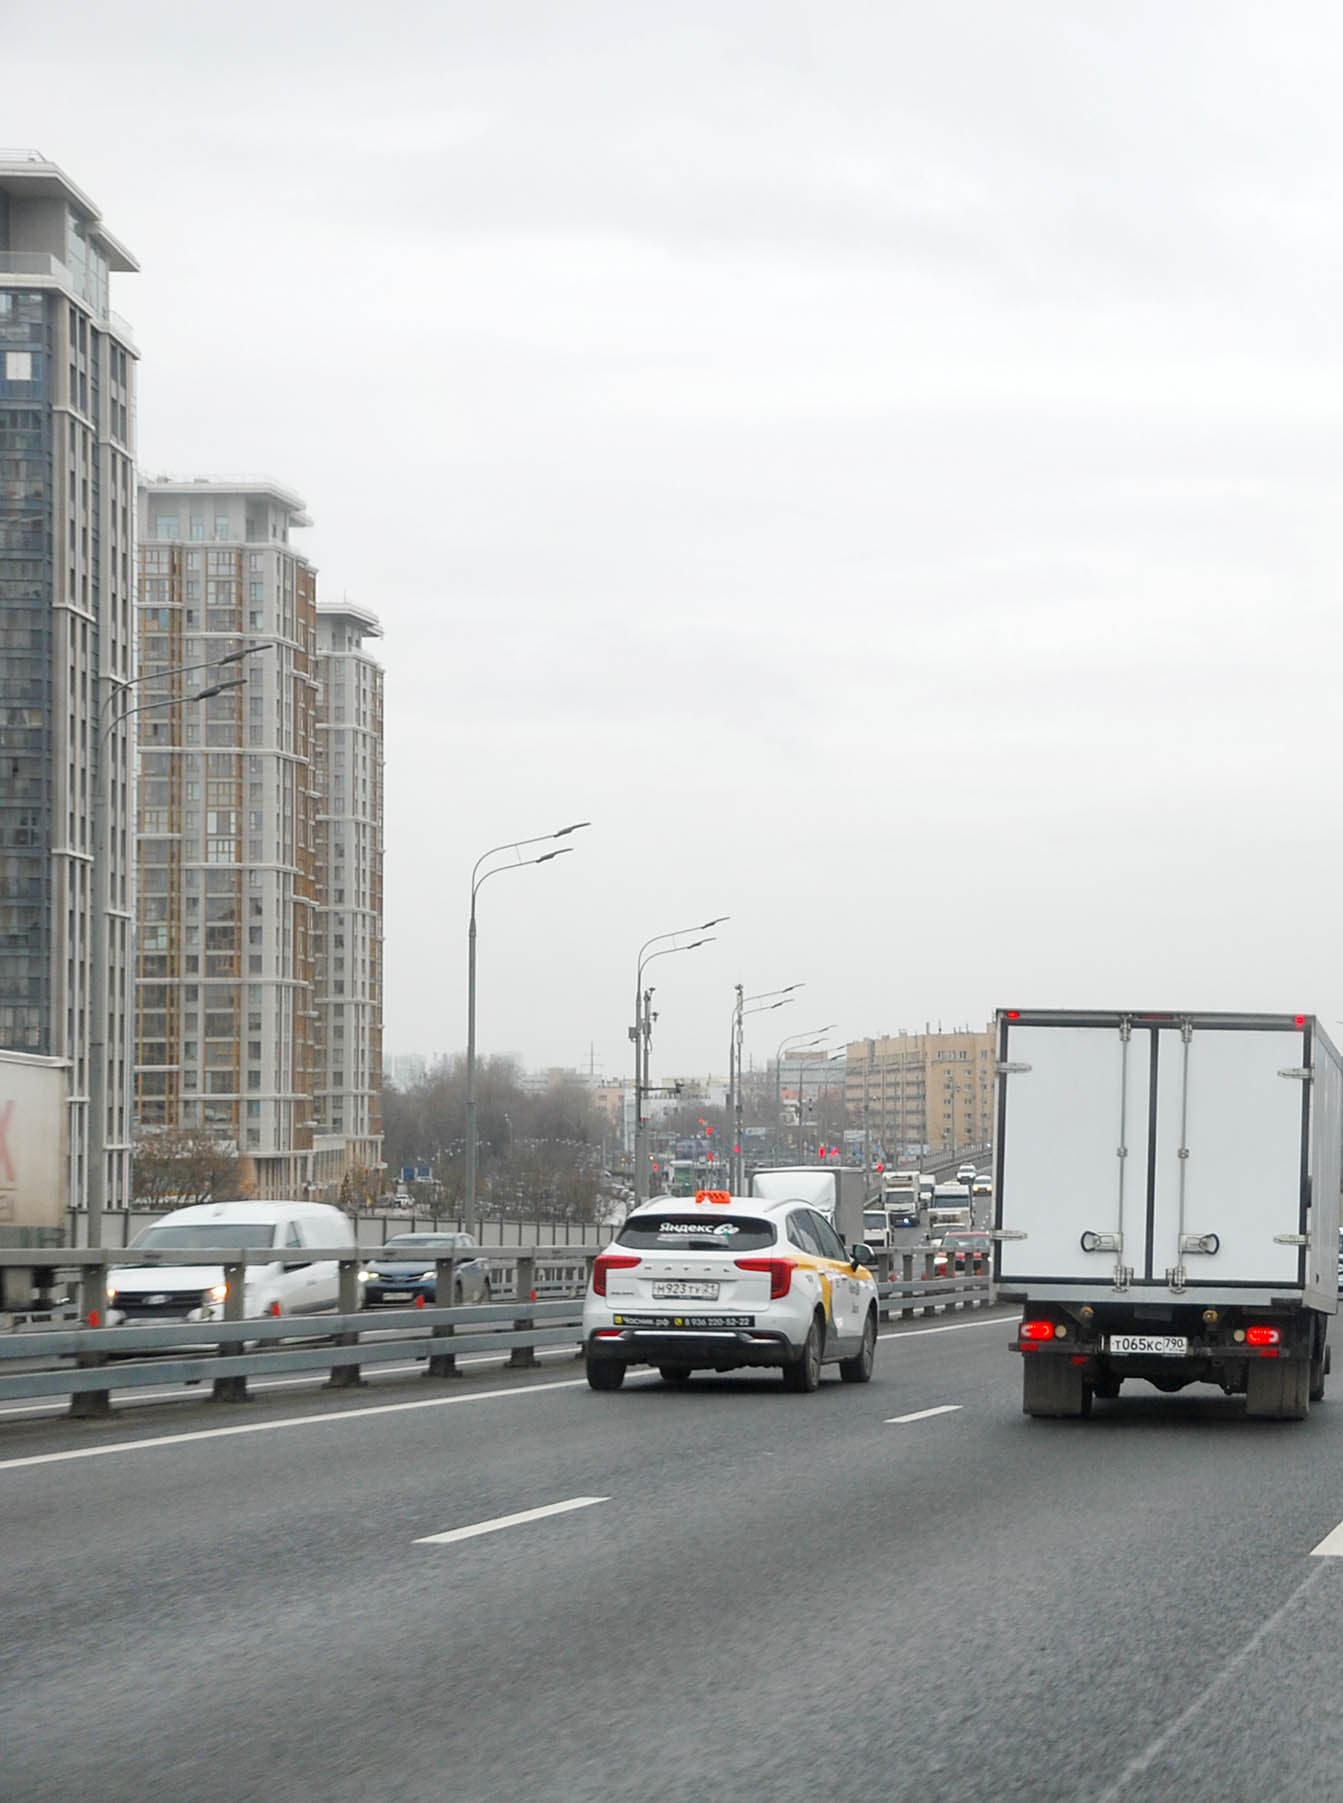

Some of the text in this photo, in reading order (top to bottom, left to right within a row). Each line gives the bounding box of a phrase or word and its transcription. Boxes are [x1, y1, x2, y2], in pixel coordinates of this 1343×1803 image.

[659, 1222, 741, 1235] Яндекс Go
[1114, 1338, 1184, 1351] Т065КС 790
